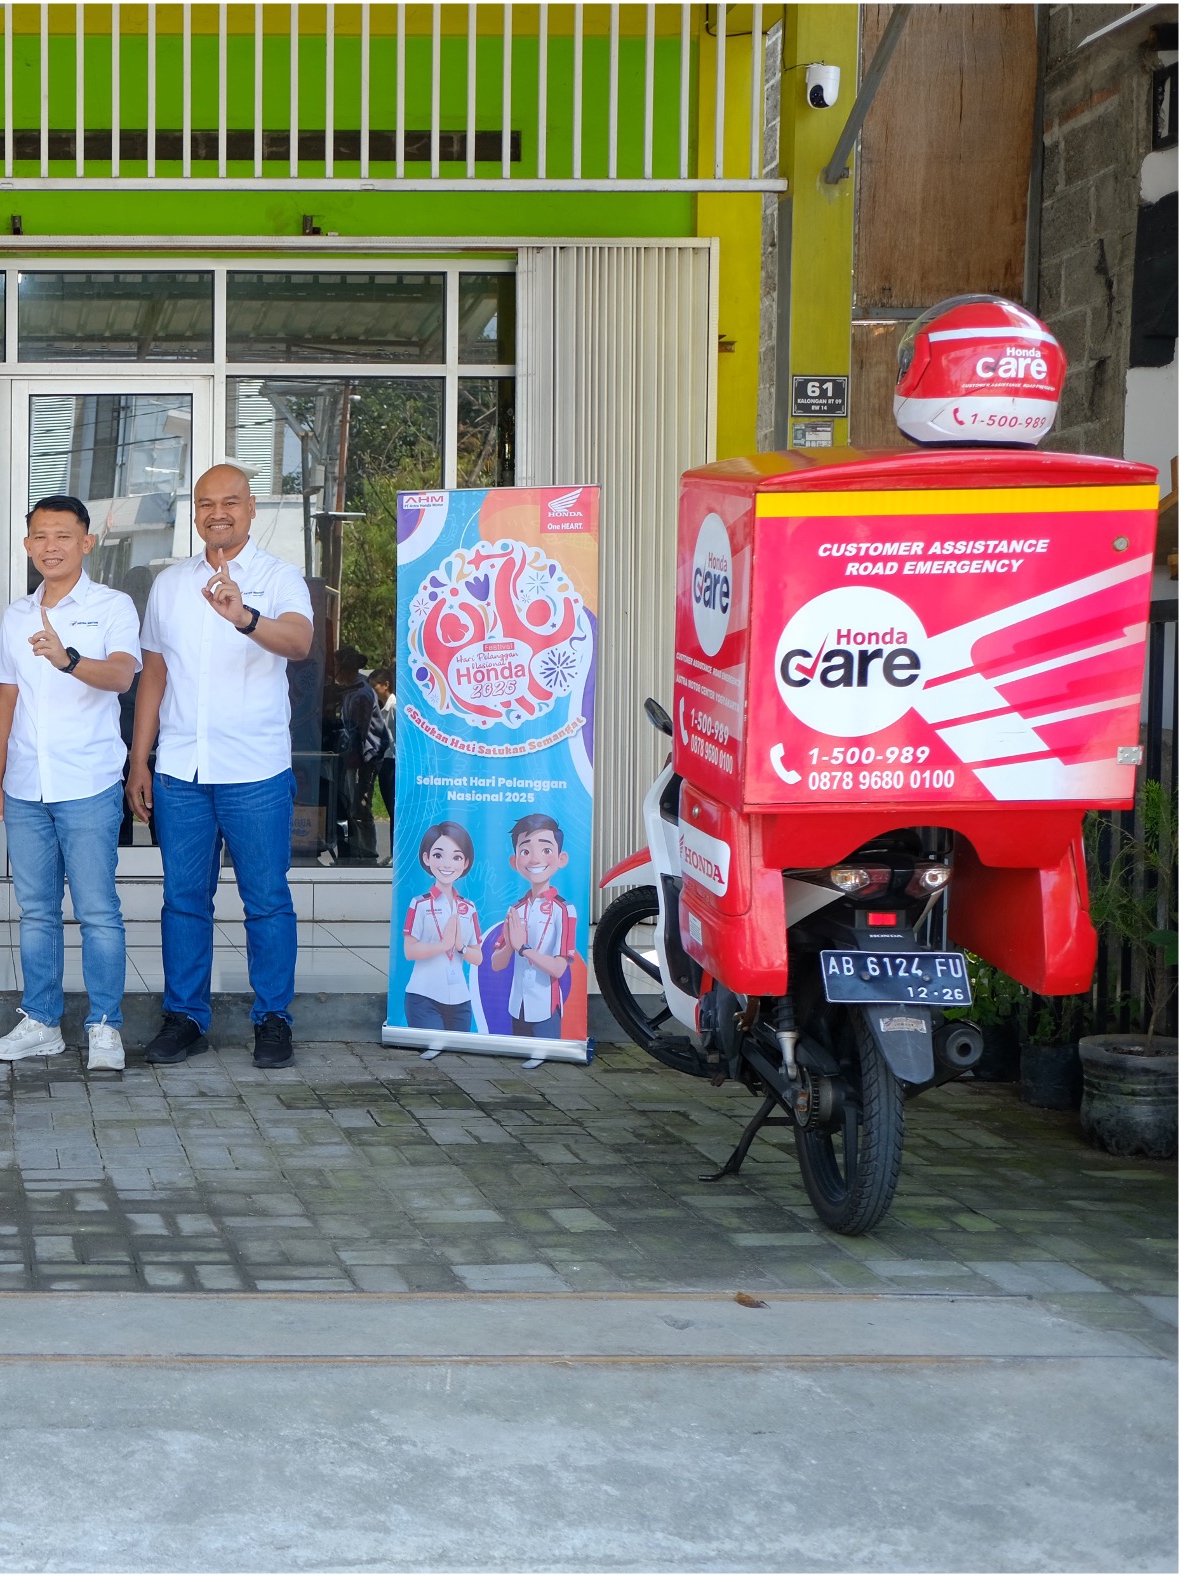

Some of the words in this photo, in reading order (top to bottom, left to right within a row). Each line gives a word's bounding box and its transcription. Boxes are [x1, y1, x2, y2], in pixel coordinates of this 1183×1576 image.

[1006, 347, 1041, 358] Honda
[976, 357, 1047, 379] care
[807, 381, 833, 397] 61
[971, 413, 1047, 429] 1-500-989
[404, 495, 444, 504] AHM
[547, 522, 560, 530] One
[818, 541, 923, 557] CUSTOMER
[928, 539, 1051, 556] ASSISTANCE
[708, 552, 728, 572] Honda
[845, 562, 898, 576] ROAD
[903, 559, 1024, 575] EMERGENCY
[694, 567, 730, 615] care
[836, 628, 908, 645] Honda
[484, 643, 513, 651] Festival
[456, 655, 476, 663] Hari
[477, 652, 519, 662] Pelanggan
[471, 658, 507, 670] Nasional
[456, 661, 526, 686] Honda
[780, 647, 922, 689] care
[470, 679, 517, 699] 2025
[406, 707, 449, 744] #Satukan
[450, 738, 476, 753] Hati
[478, 745, 526, 755] Satukan
[528, 717, 584, 750] Semangat
[691, 708, 729, 746] 1-500-989
[691, 734, 705, 758] 0878
[704, 741, 719, 766] 9680
[719, 749, 733, 775] 0100
[808, 746, 930, 765] 1-500-989
[416, 775, 468, 787] Selamat
[469, 776, 496, 787] Hari
[498, 777, 567, 791] Pelanggan
[808, 771, 853, 791] 0878
[859, 770, 904, 790] 9680
[910, 769, 955, 789] 0100
[447, 790, 503, 802] Nasional
[505, 792, 535, 803] 2025
[291, 818, 311, 828] QUA
[684, 846, 725, 885] HONDA
[828, 956, 855, 976] AB
[866, 956, 923, 977] 6124
[935, 958, 963, 978] FU
